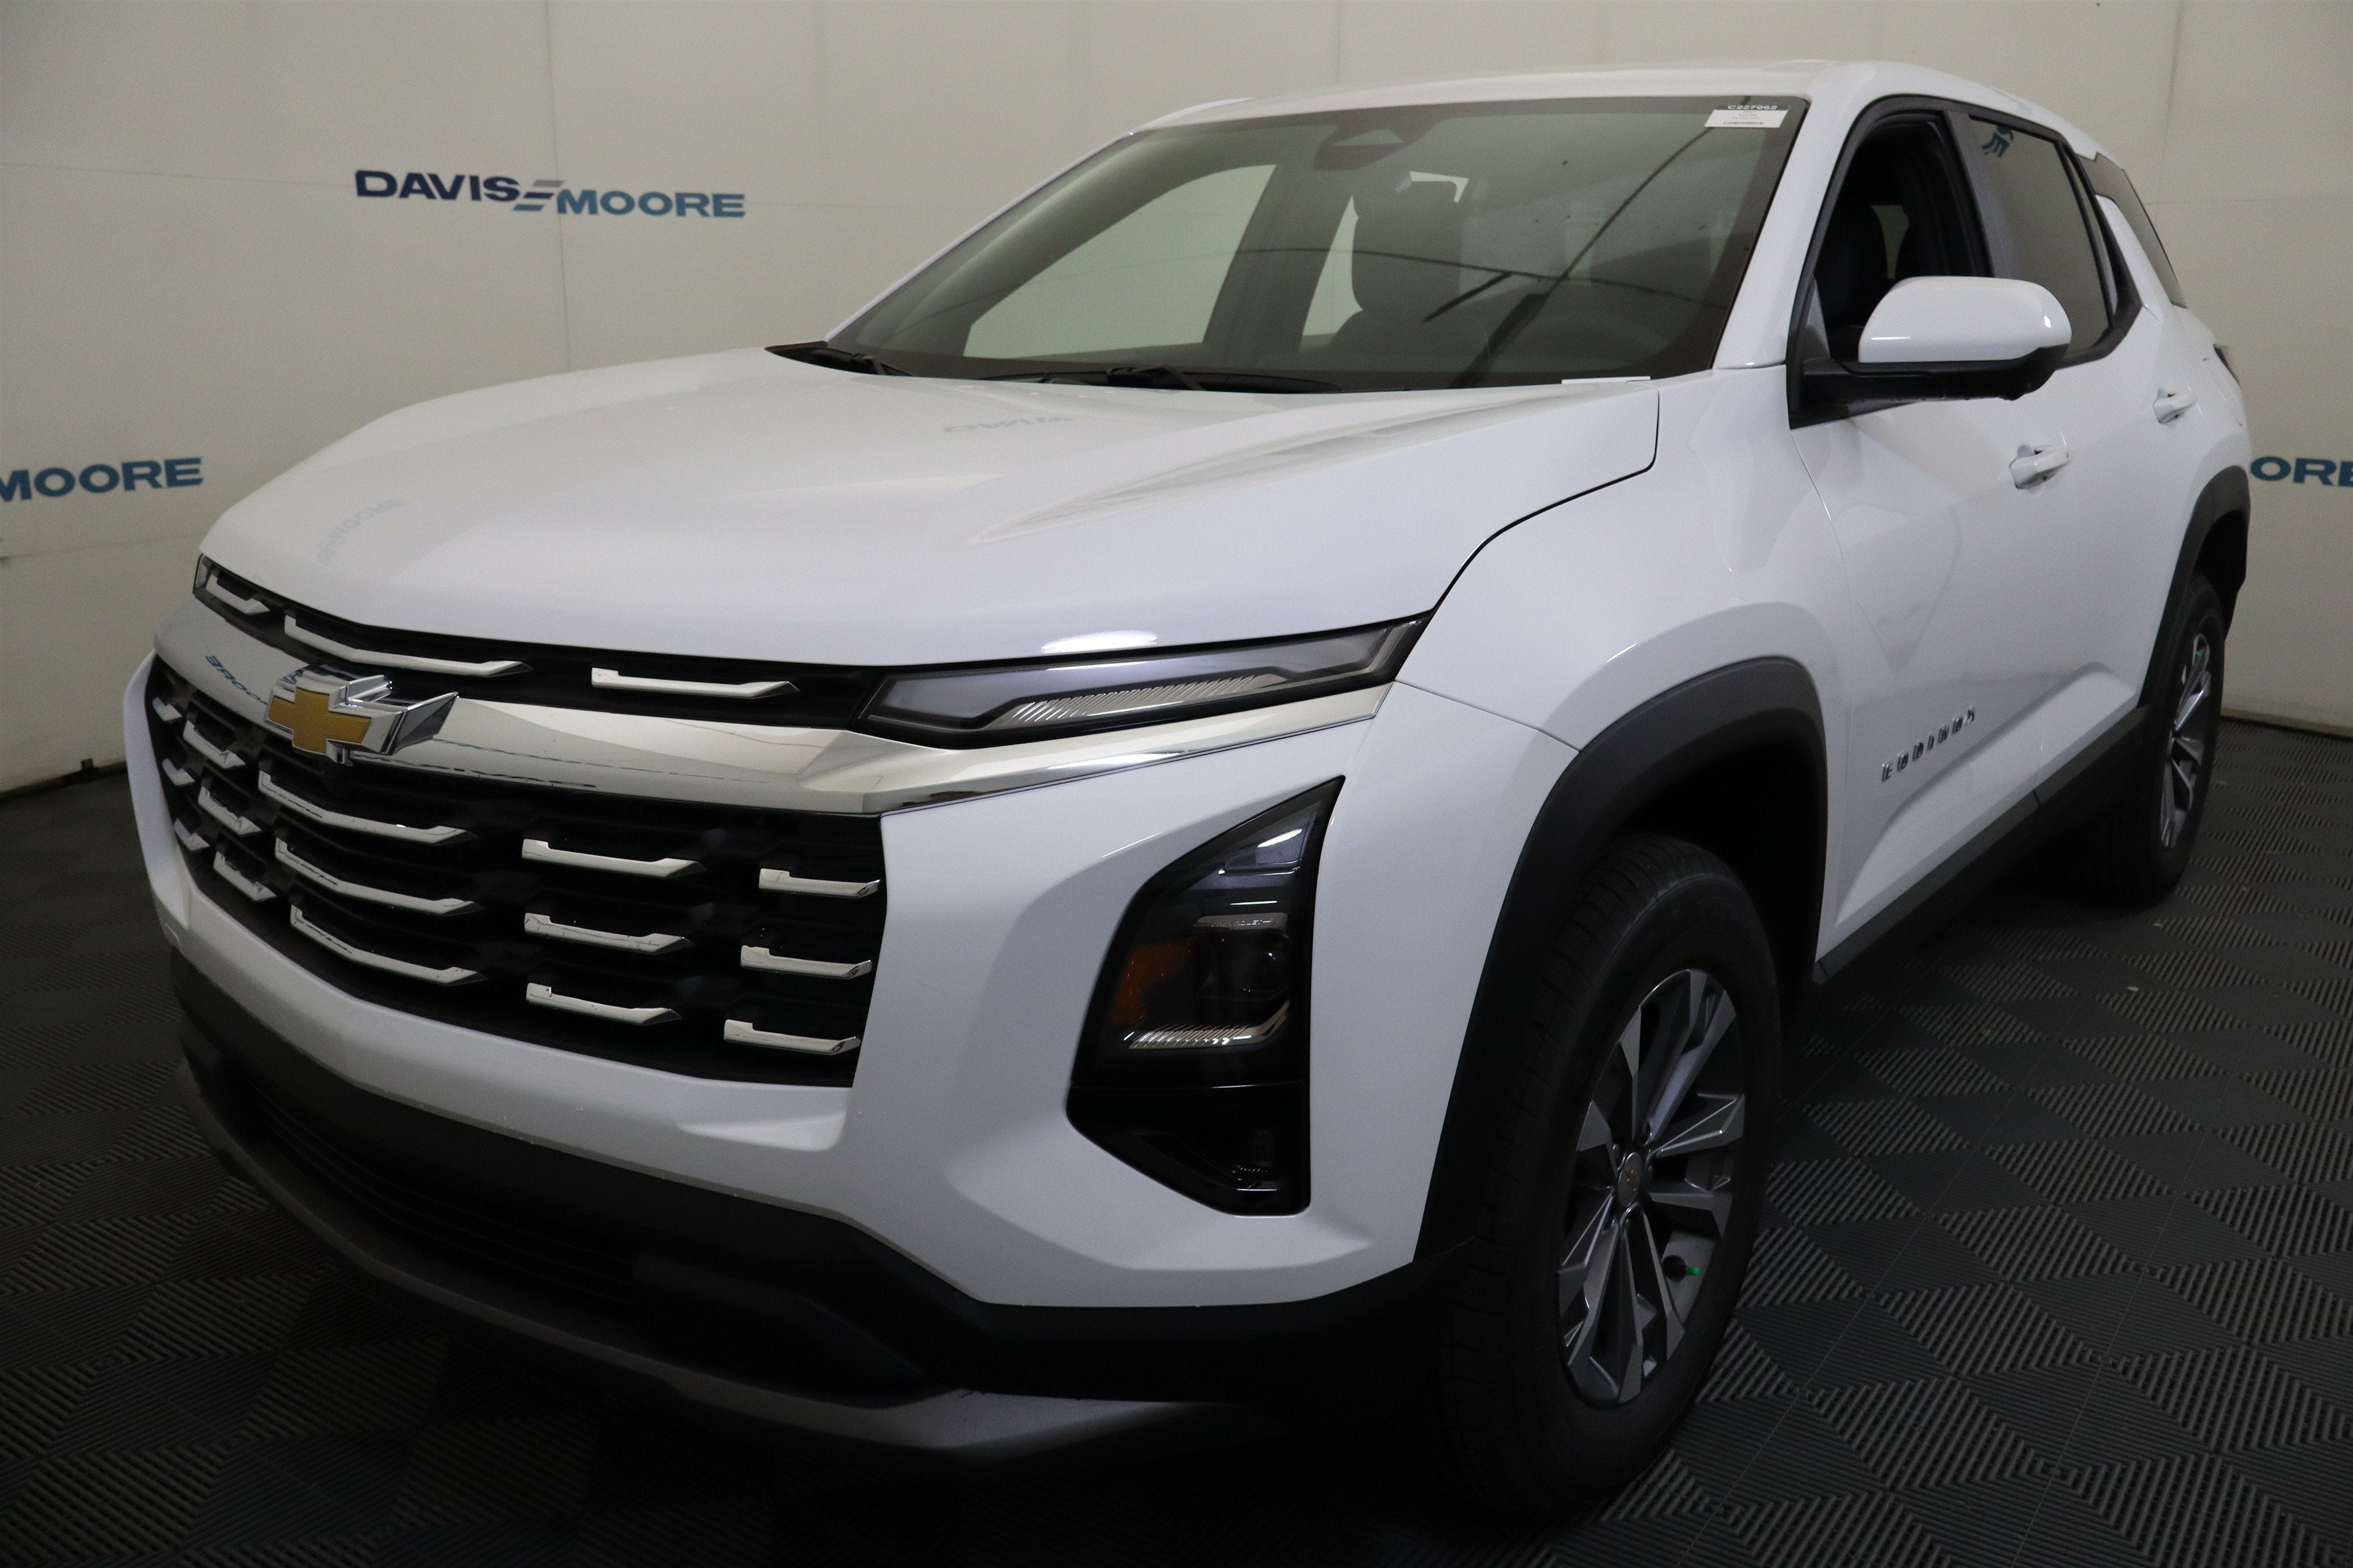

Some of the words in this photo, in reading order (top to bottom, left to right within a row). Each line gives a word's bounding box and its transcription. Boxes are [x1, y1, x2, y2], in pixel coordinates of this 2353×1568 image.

[355, 170, 521, 202] DAVIS
[557, 190, 746, 218] MOORE
[0, 457, 203, 502] MOORE
